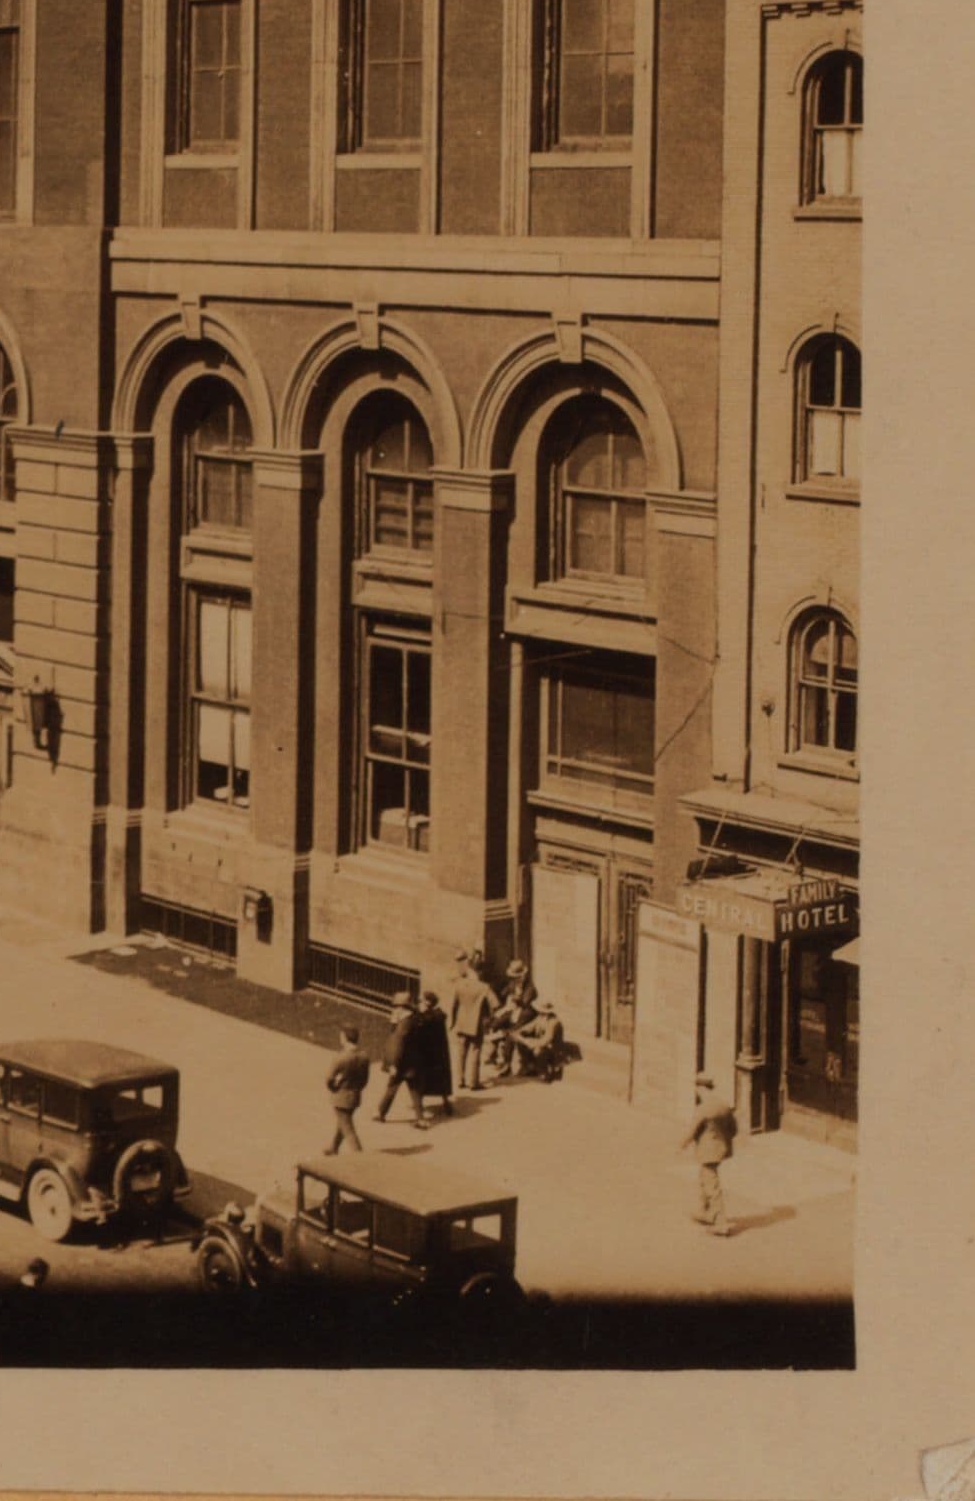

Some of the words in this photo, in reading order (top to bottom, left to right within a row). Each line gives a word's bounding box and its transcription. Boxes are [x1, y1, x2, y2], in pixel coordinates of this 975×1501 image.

[790, 881, 837, 905] FAMILY
[682, 892, 768, 930] CENTRAL
[780, 903, 849, 933] HOTEL
